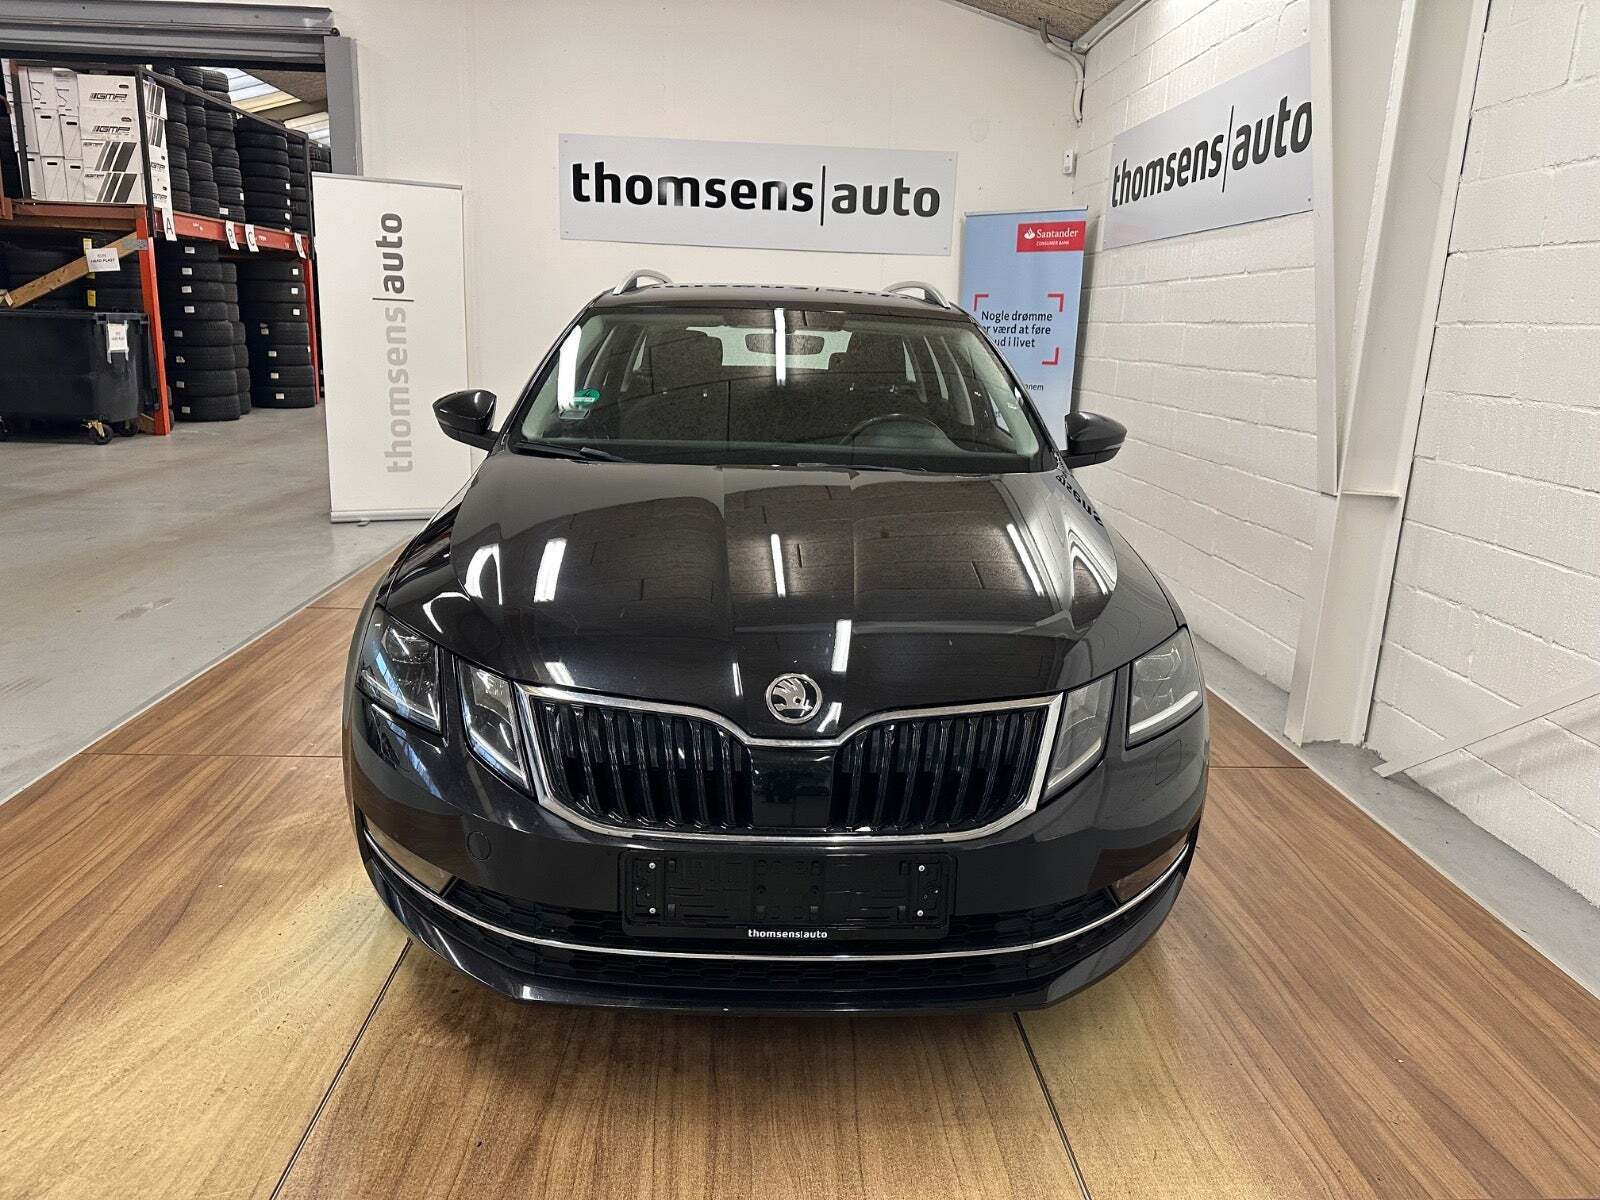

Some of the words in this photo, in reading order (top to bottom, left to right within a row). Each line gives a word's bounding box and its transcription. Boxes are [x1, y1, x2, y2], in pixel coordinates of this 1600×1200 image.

[166, 216, 174, 234] A
[1036, 227, 1079, 238] Santander
[981, 310, 1010, 323] Nogle
[1011, 310, 1053, 321] drømme
[993, 324, 1017, 334] værd
[1019, 326, 1030, 334] at
[1032, 323, 1051, 334] føre
[1013, 336, 1036, 347] livet
